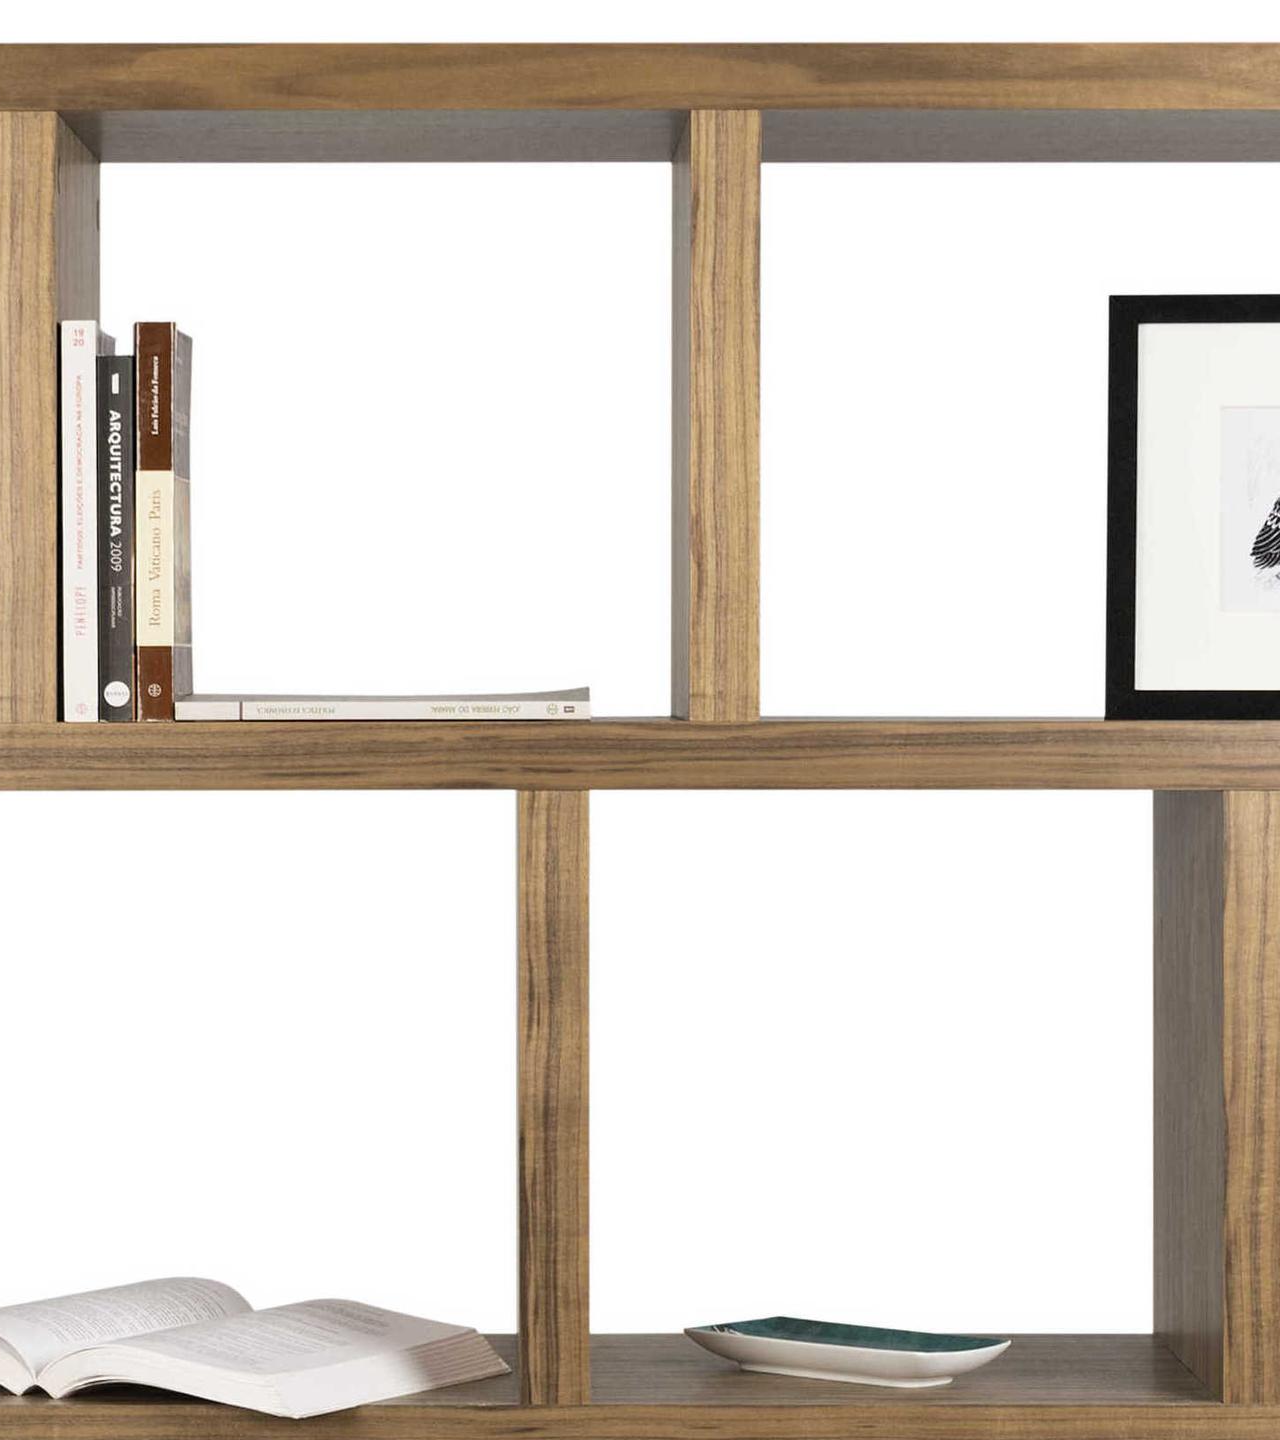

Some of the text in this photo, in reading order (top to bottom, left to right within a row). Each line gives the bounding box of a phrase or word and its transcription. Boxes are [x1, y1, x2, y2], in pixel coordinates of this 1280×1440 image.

[109, 411, 122, 571] ARQUITECTURA 2009
[148, 490, 160, 626] Roma Vaticano Paris
